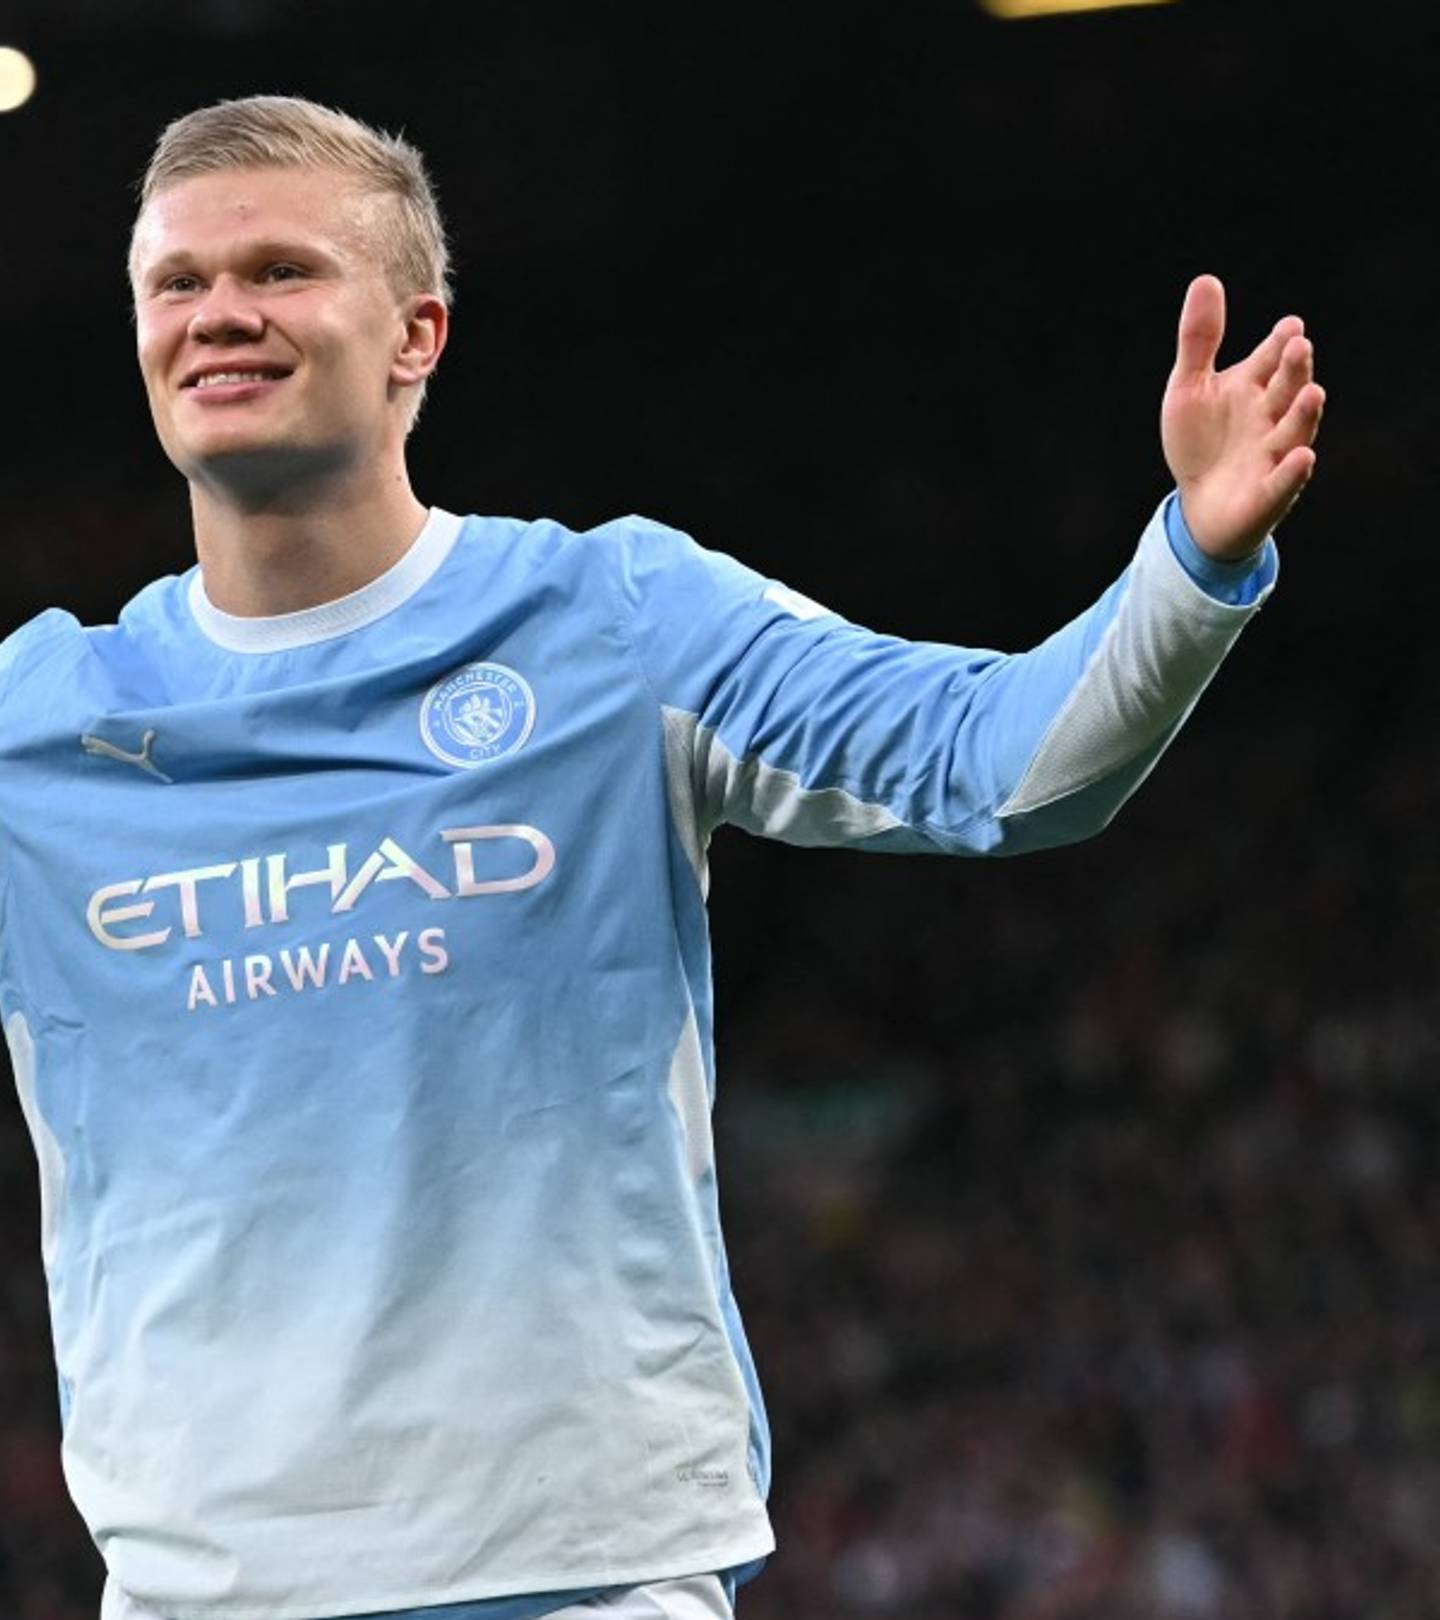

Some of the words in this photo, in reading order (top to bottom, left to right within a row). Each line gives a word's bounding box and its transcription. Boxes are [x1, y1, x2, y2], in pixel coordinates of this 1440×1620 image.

[431, 670, 519, 711] MANCHESTER
[469, 744, 502, 760] CITY
[86, 824, 556, 950] ETIHAD
[186, 928, 450, 1011] AIRWAYS
